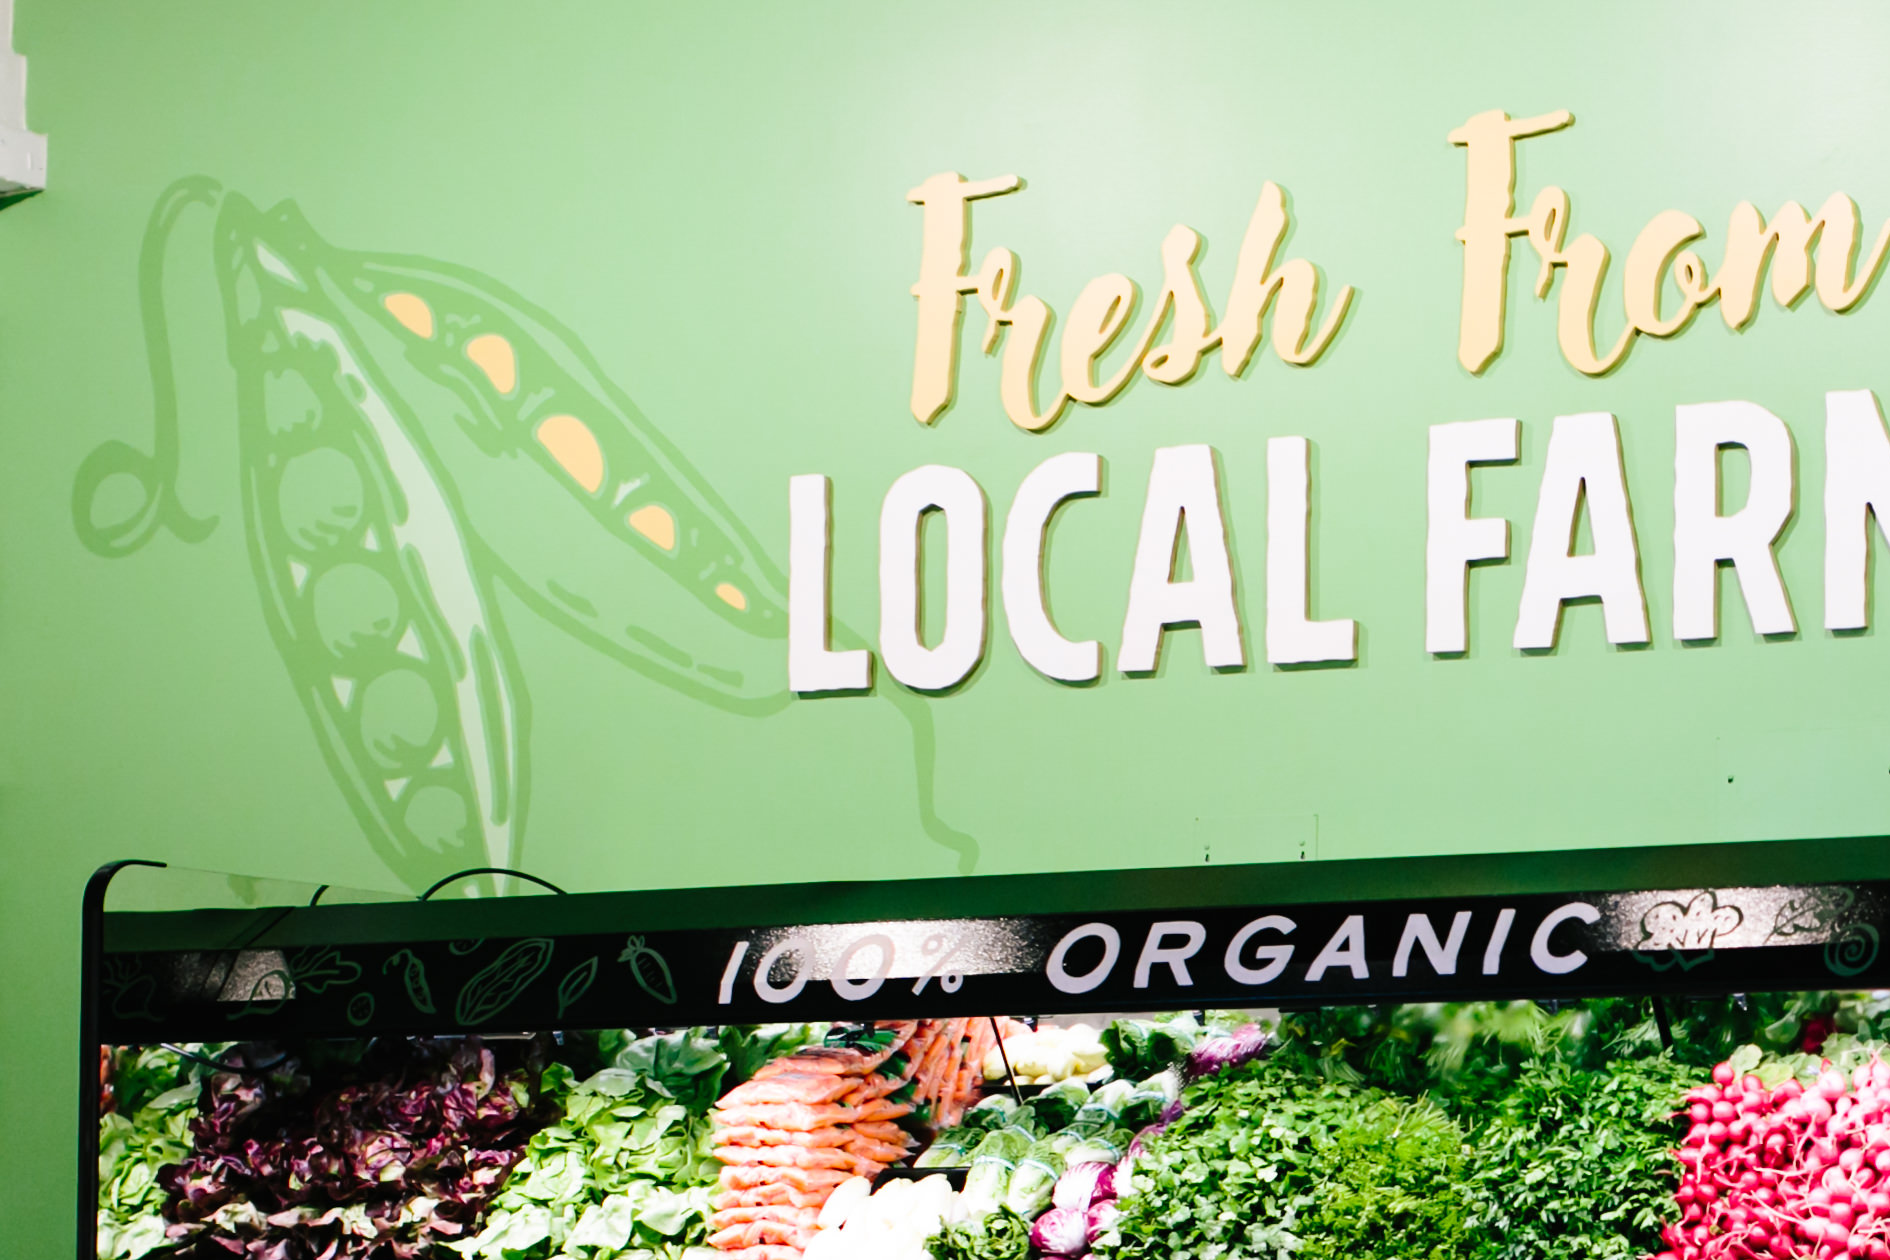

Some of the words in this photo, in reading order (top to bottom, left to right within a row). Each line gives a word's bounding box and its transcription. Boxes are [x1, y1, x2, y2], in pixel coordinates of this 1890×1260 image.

[905, 171, 1357, 431] Fresh
[789, 436, 1358, 696] LOCAL
[718, 932, 964, 1004] 100%
[1045, 902, 1601, 993] ORGANIC
